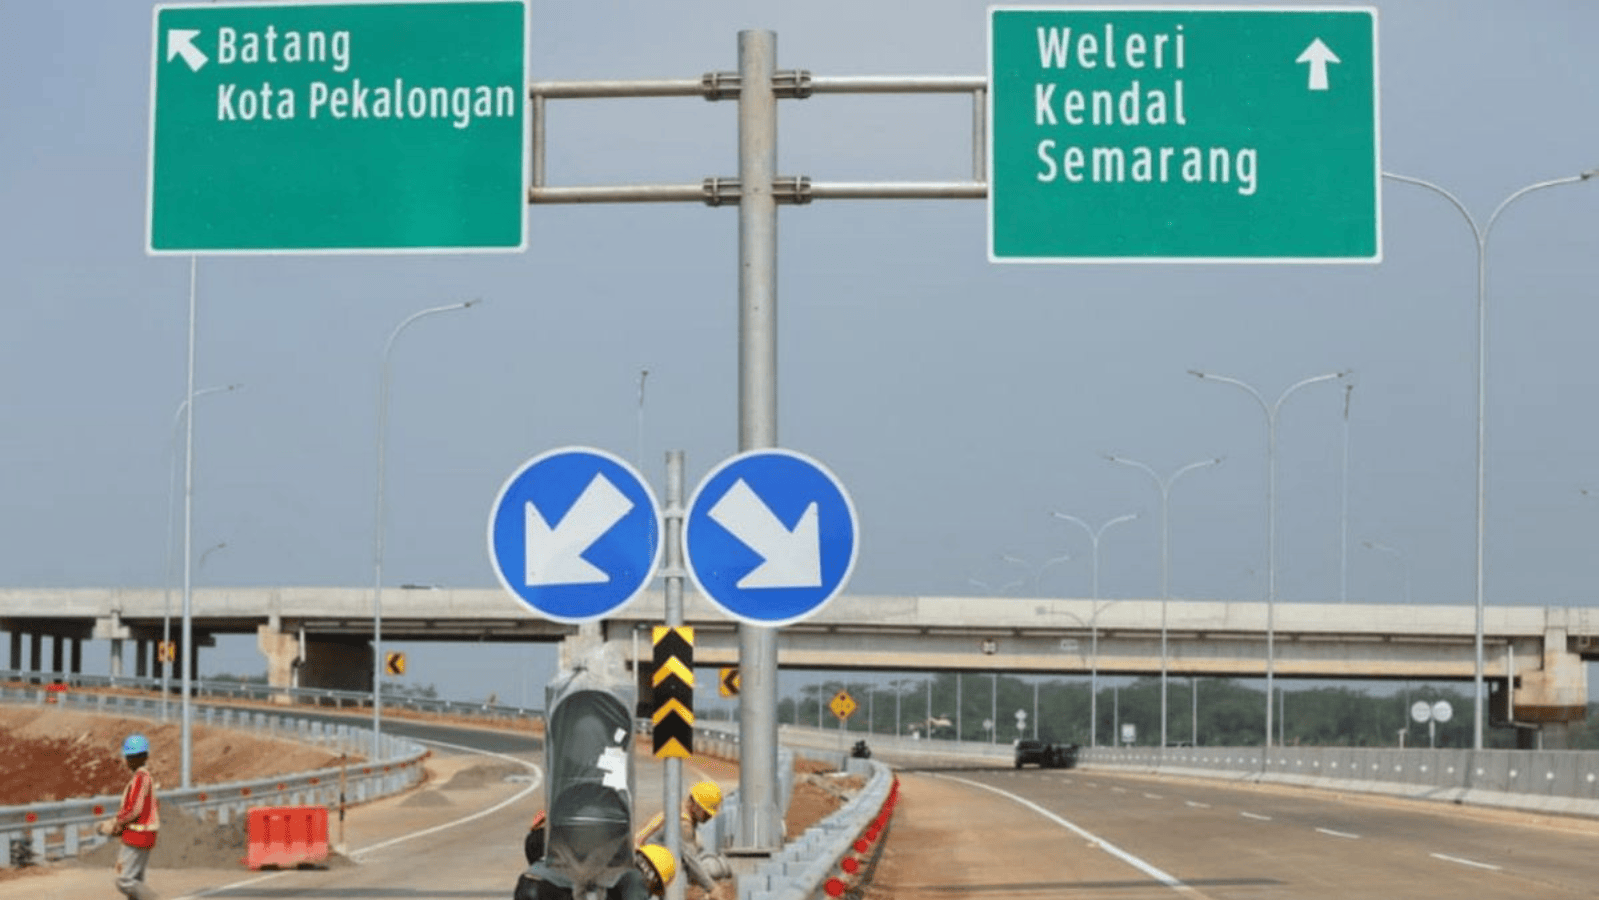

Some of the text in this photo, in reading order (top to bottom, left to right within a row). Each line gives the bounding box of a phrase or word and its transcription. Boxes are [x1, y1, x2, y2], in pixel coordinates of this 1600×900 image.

[217, 26, 351, 73] Batang
[1036, 24, 1185, 69] Weleri
[217, 79, 515, 129] Kota Pekalongan
[1035, 80, 1187, 126] Kendal
[1036, 139, 1258, 196] Semarang
